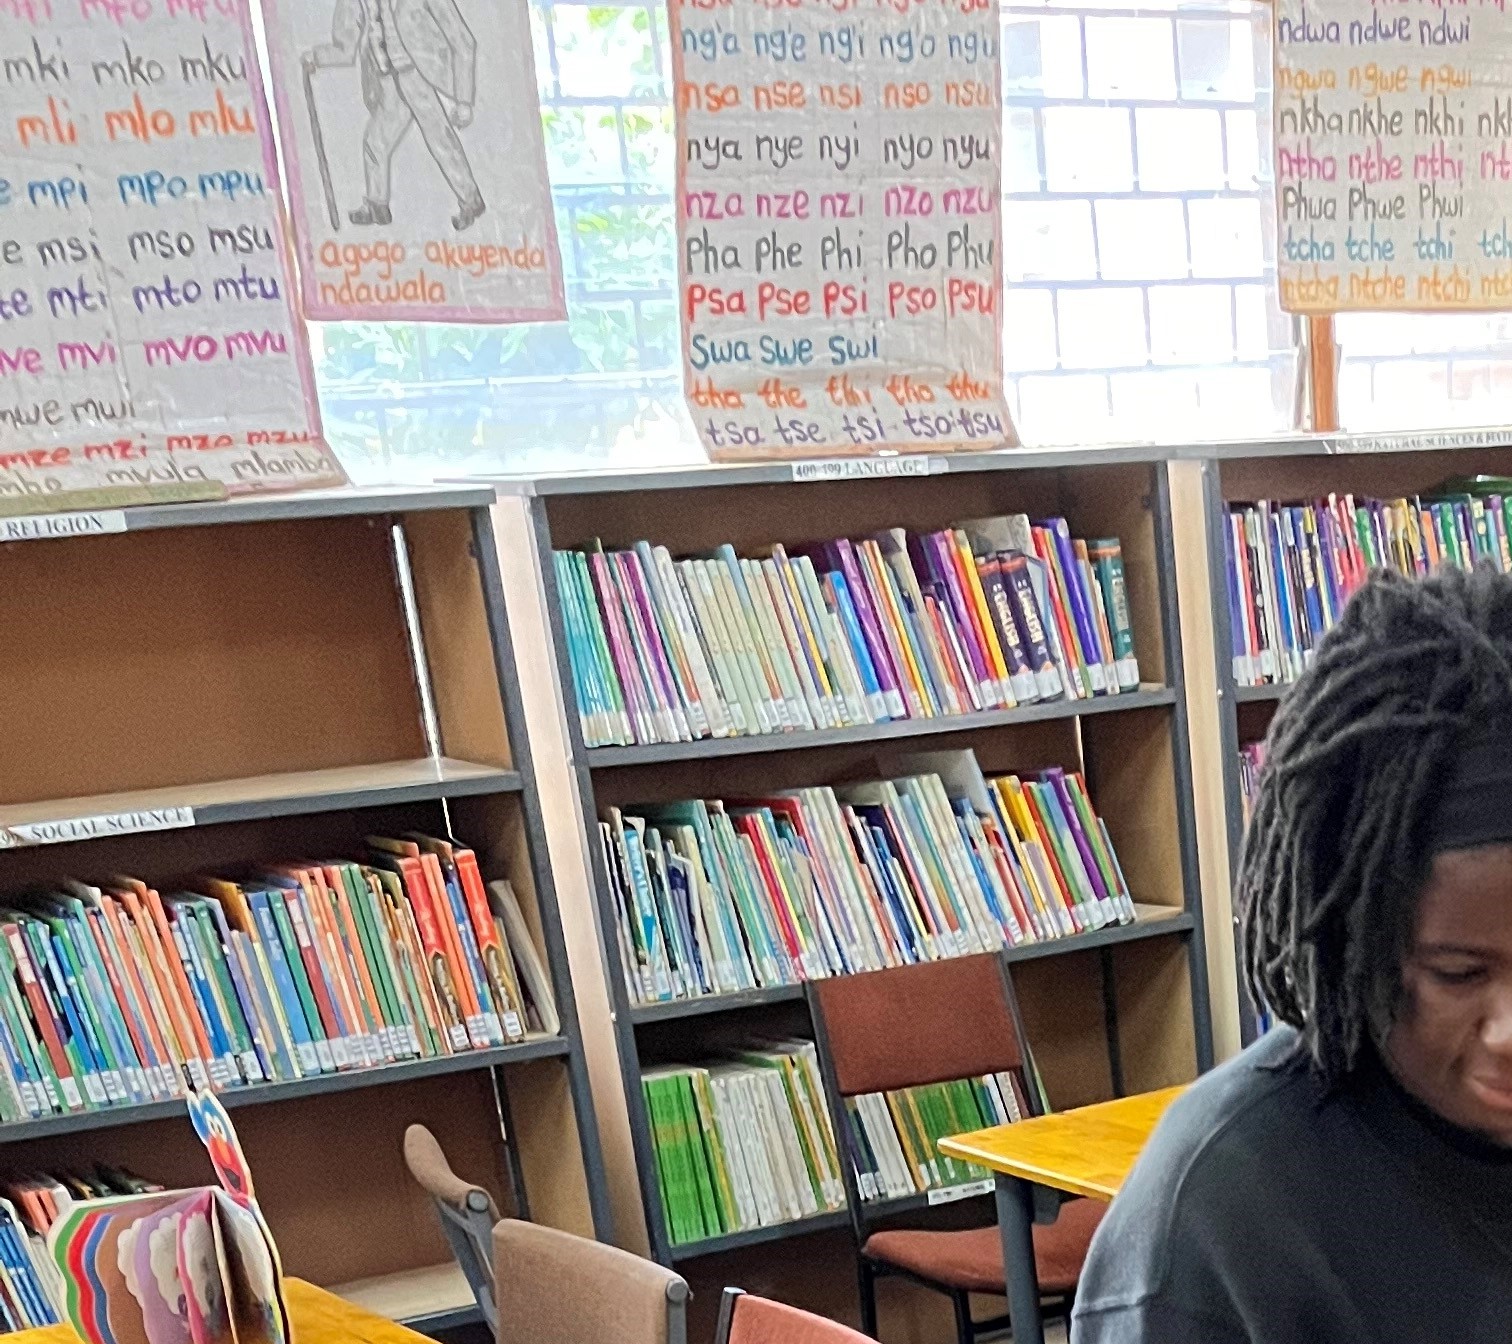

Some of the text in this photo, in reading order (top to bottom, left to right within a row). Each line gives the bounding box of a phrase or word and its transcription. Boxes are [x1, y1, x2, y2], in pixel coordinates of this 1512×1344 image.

[1278, 7, 1340, 44] ndwa
[1350, 7, 1411, 45] ndwe
[1419, 8, 1470, 45] ndwi
[4, 34, 248, 86] mki mko mku
[17, 87, 256, 149] mli mlo mlu
[682, 80, 994, 112] nsa nse nsi nso nsu
[1280, 93, 1342, 138] nkha
[1349, 97, 1403, 138] nkhe
[1414, 96, 1464, 137] nkhi
[687, 121, 990, 171] nya nye nyi nyo nyu
[27, 162, 266, 210] mpi mpo mpu
[686, 174, 993, 220] nza nze nzi nzo nzu
[36, 223, 274, 267] msi mso msu
[320, 234, 547, 281] agogo akuyenda
[48, 264, 281, 318] mti mto mtu
[321, 268, 446, 305] ndawala
[57, 328, 288, 371] mvi mvo mvu
[706, 406, 1003, 446] tsa tse tsi tso tsu
[845, 459, 922, 476] LANGUAGE
[6, 515, 104, 538] RELIGION
[31, 806, 187, 840] SOCIAL SCIENCE
